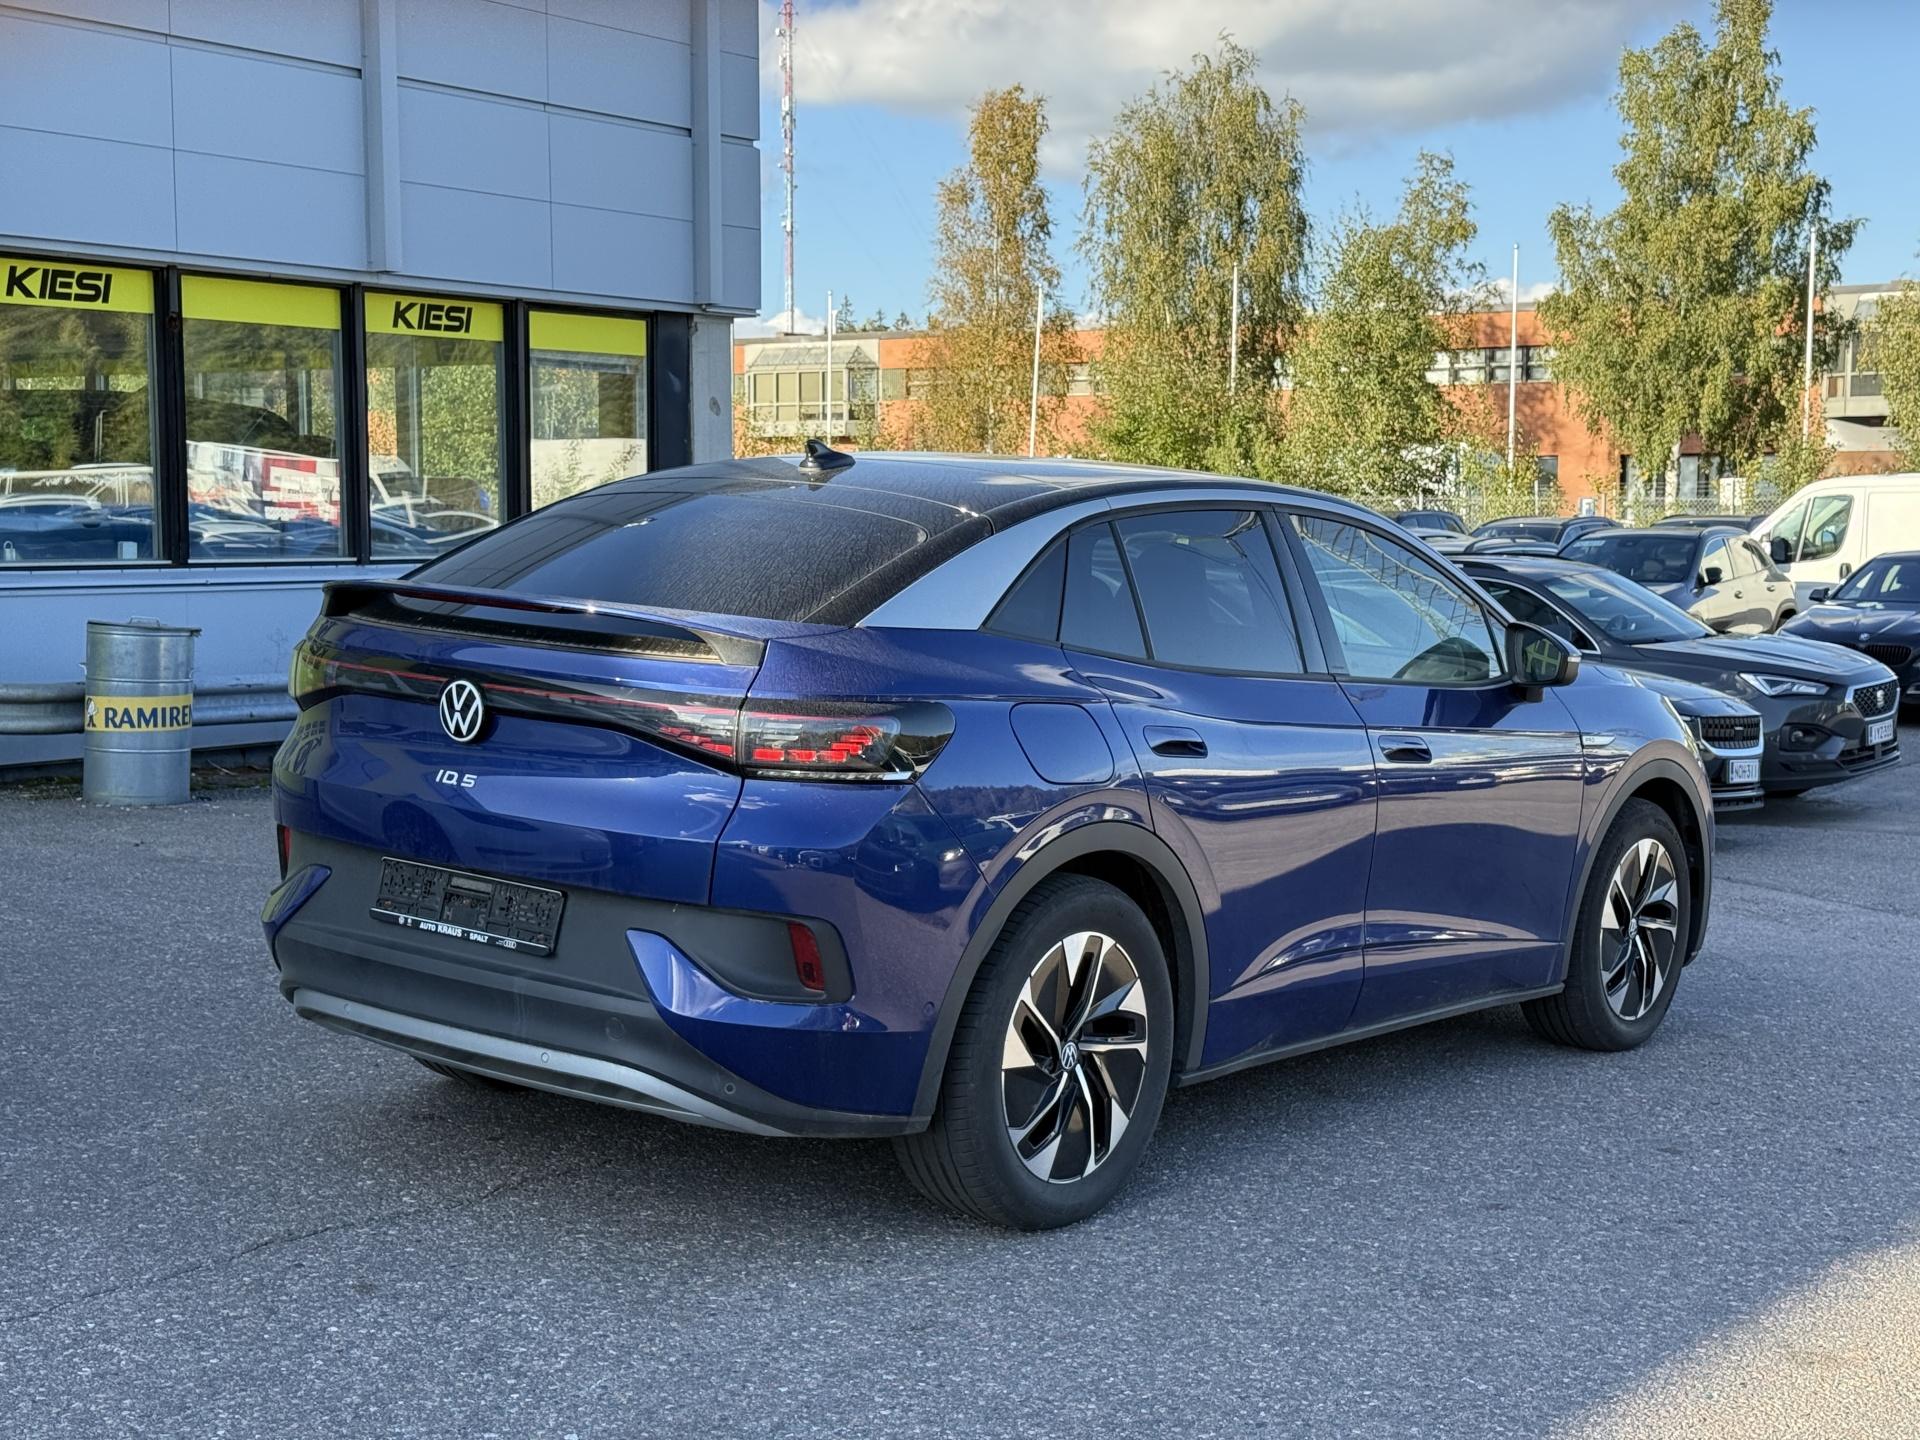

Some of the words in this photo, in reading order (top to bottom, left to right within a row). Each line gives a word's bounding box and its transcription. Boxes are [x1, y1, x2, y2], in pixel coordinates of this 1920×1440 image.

[6, 266, 112, 304] KIESI
[392, 301, 473, 334] KIESI
[419, 921, 436, 933] AUTO
[437, 923, 463, 938] KRAUS
[469, 932, 489, 944] SPALT
